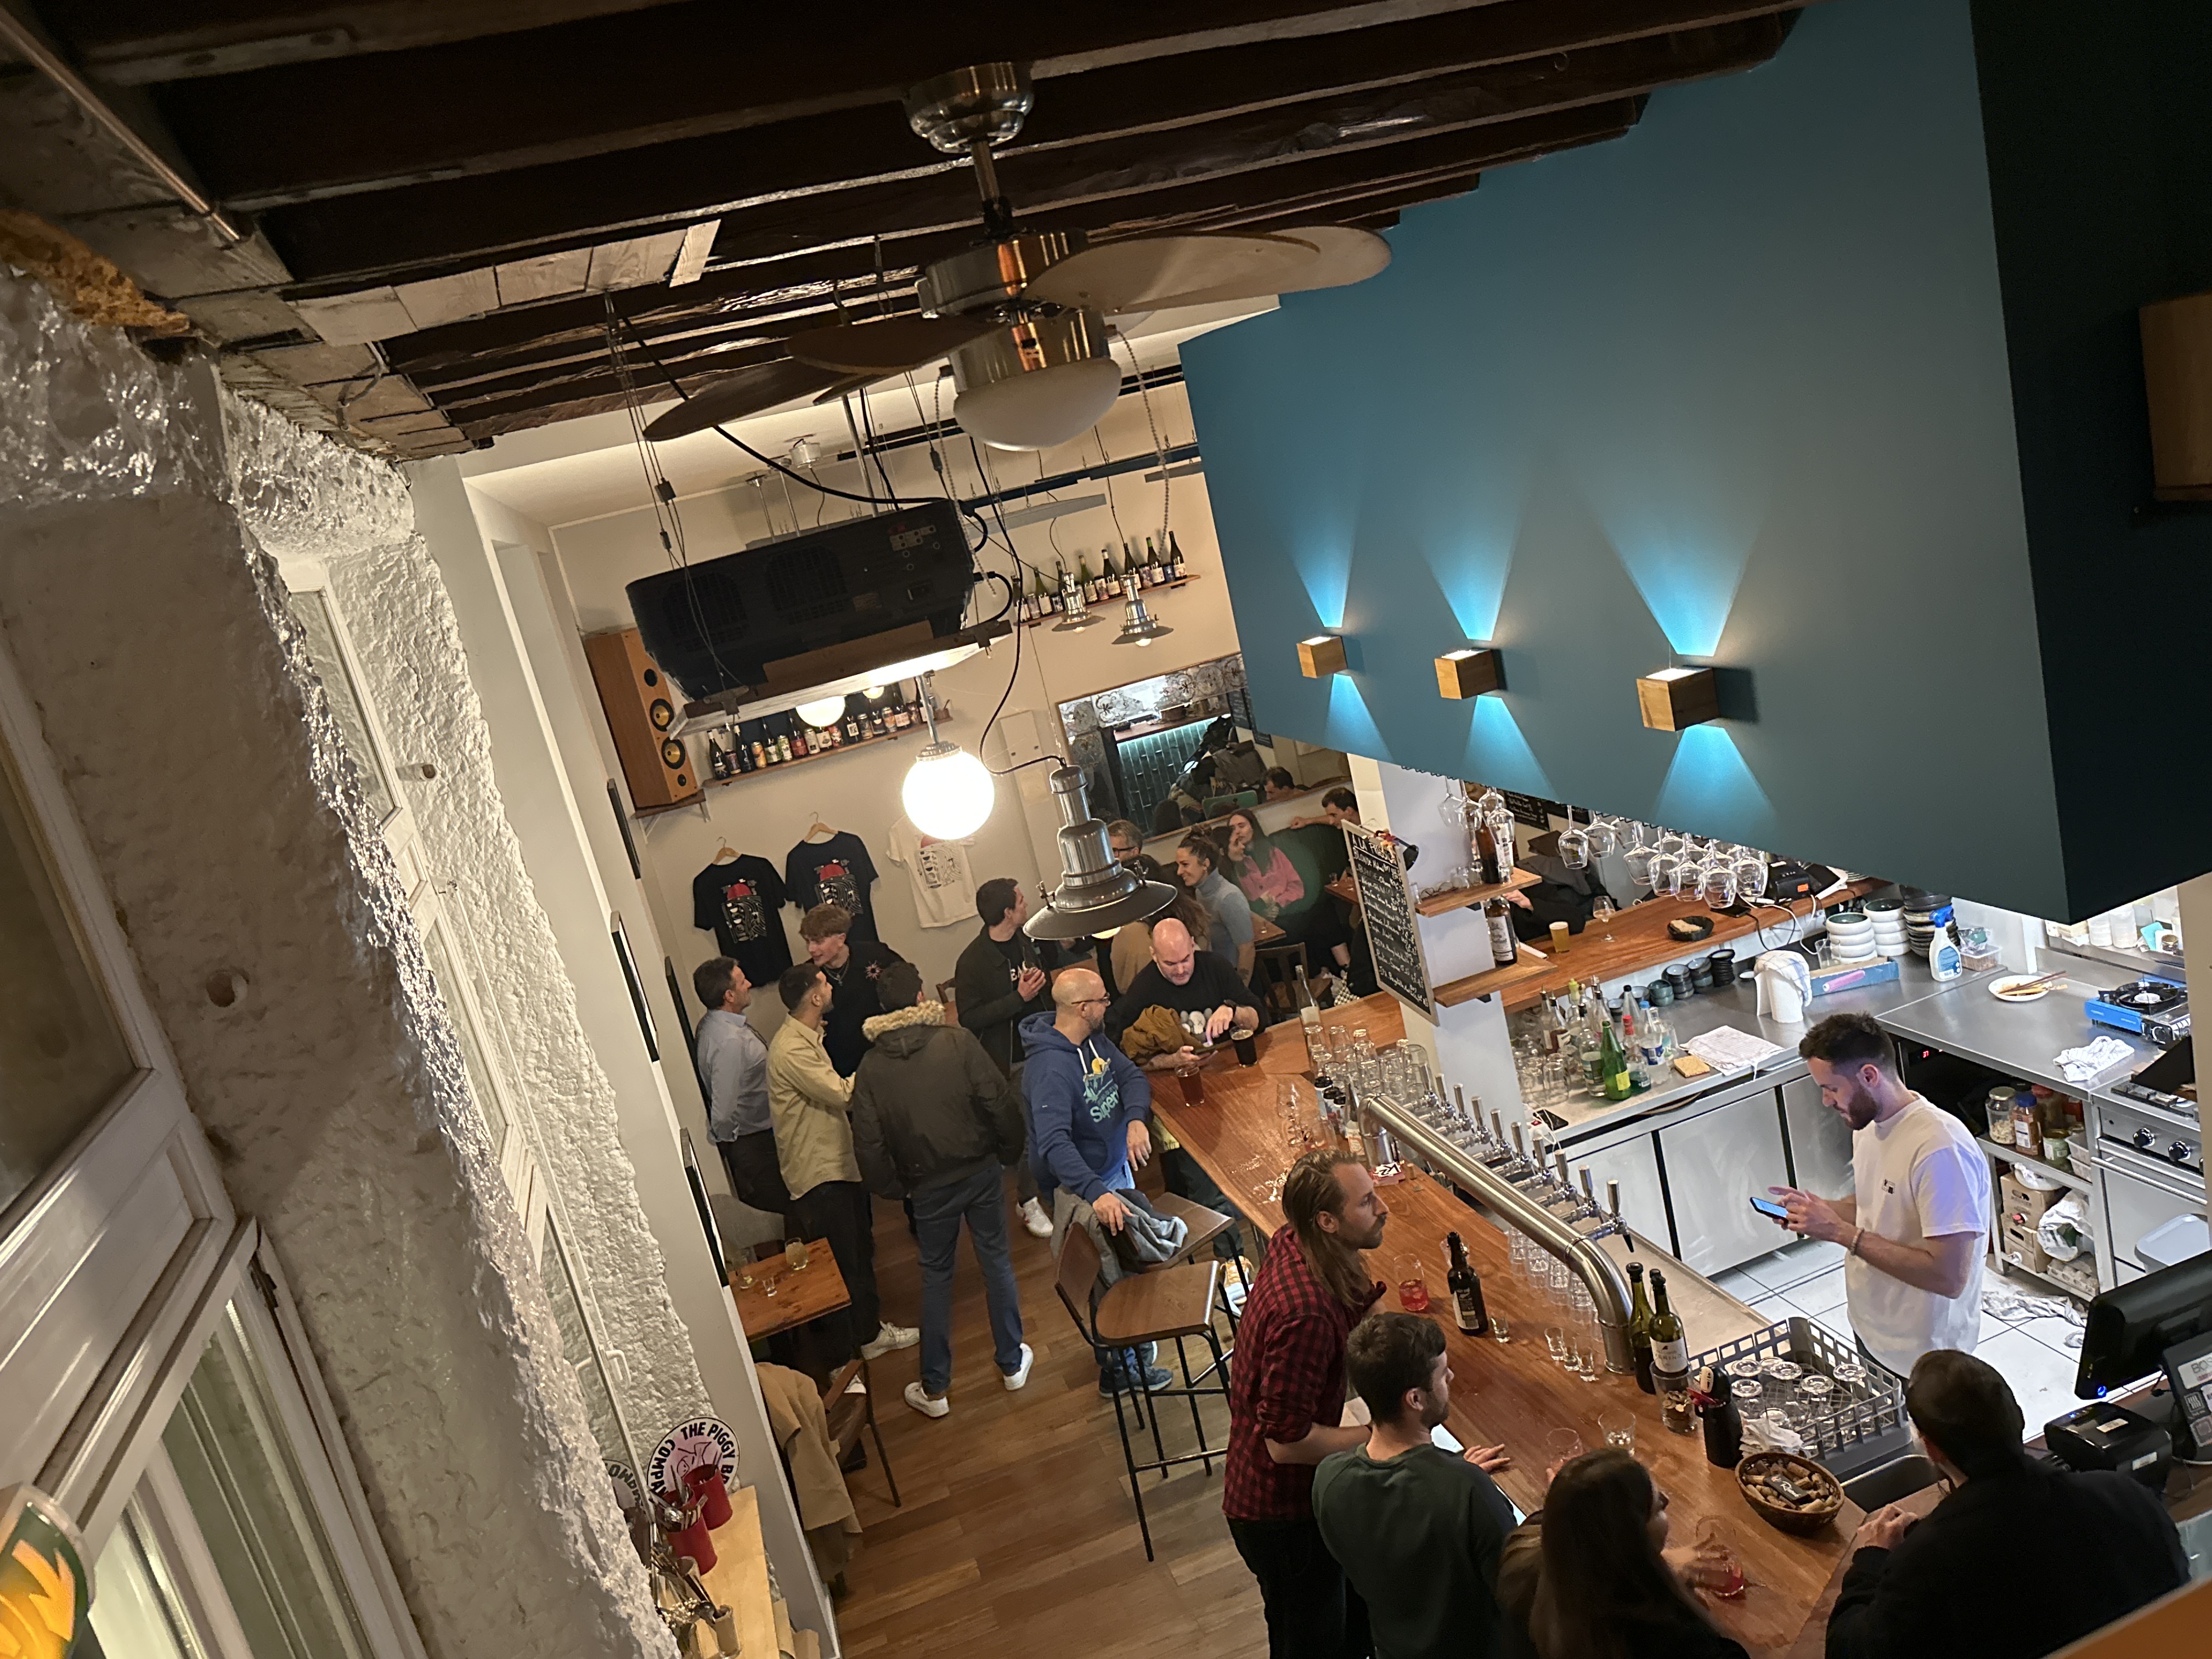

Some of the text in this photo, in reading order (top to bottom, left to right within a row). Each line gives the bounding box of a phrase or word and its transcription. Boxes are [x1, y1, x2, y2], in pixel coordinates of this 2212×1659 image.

[1090, 1090, 1119, 1122] Super
[680, 1422, 706, 1440] THE
[707, 1424, 735, 1458] PIGGY
[651, 1439, 676, 1497] COMPAN
